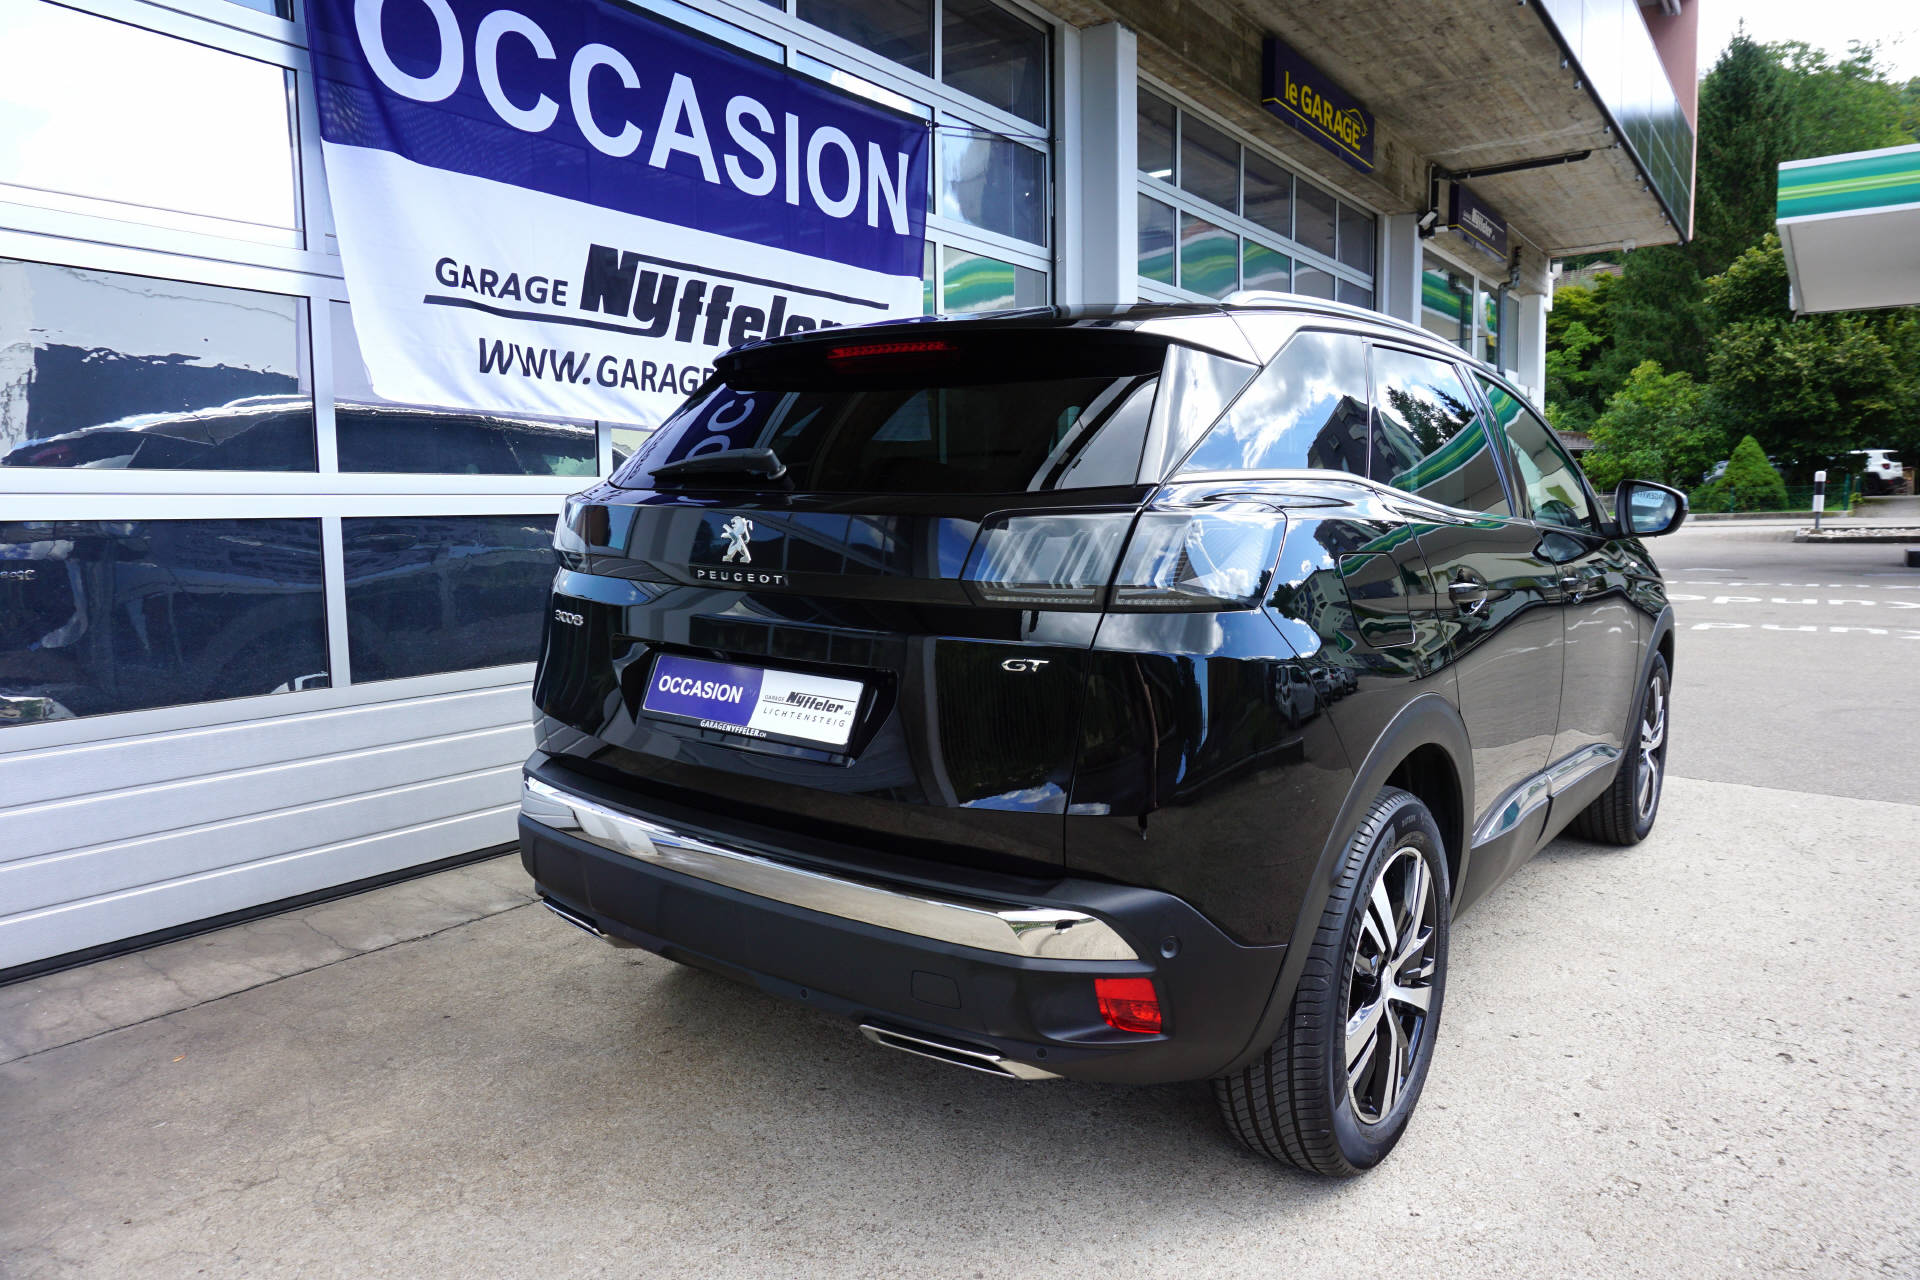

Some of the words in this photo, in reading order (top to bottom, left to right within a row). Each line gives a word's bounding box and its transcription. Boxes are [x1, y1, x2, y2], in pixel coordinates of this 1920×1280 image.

[354, 0, 910, 235] OCCASION
[1284, 71, 1298, 106] le
[1301, 85, 1361, 151] GARAGE
[435, 257, 568, 306] GARAGE
[697, 569, 784, 585] PEUGEOT
[554, 609, 584, 626] 3008
[1001, 658, 1049, 672] GT
[658, 675, 744, 704] OCCASION
[764, 695, 786, 703] GARAGE
[786, 691, 844, 713] Nyffeler
[763, 706, 846, 728] LICHTENSTEIG
